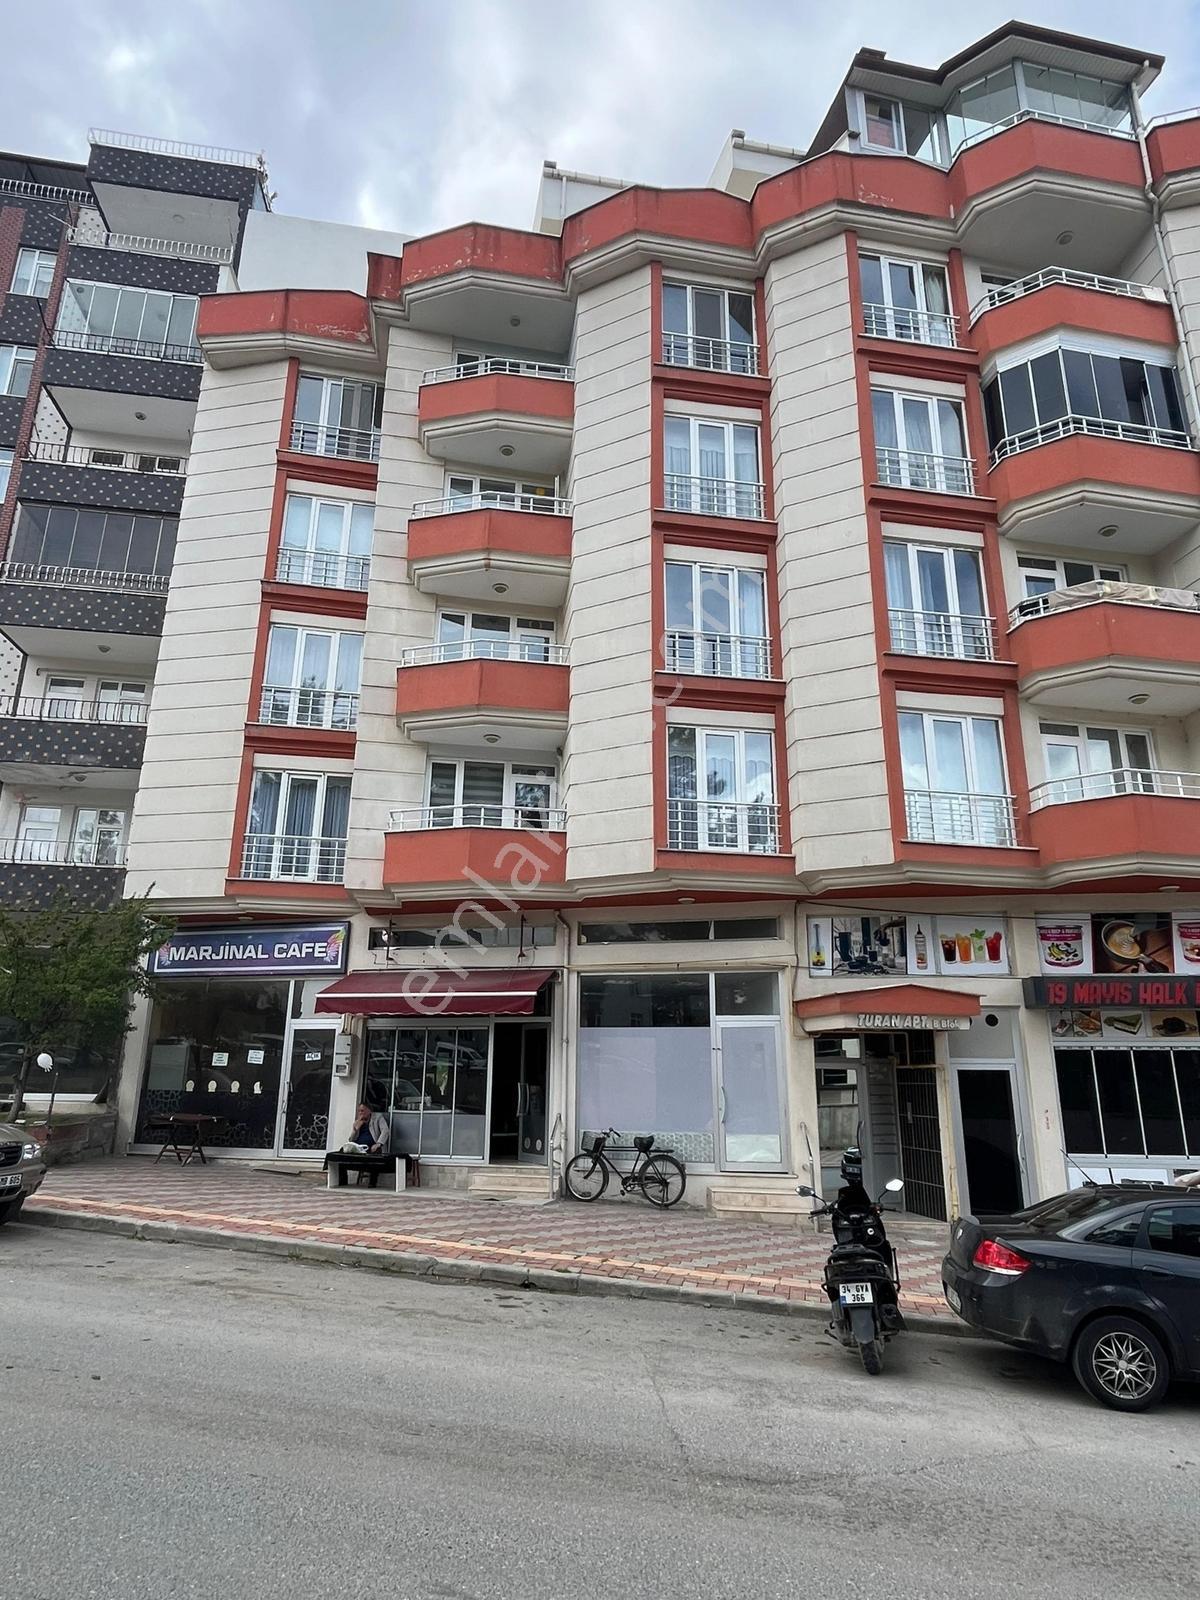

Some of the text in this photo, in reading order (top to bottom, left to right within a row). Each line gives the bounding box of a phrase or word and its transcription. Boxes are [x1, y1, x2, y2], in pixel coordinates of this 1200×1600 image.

[169, 942, 327, 960] MARJİNAL CAFE
[1047, 982, 1067, 1004] 19
[1139, 982, 1188, 1004] HALK
[858, 1014, 899, 1027] TURAN
[903, 1014, 930, 1028] APT.
[933, 1019, 940, 1028] B
[841, 1285, 851, 1293] 34
[851, 1294, 865, 1302] 366
